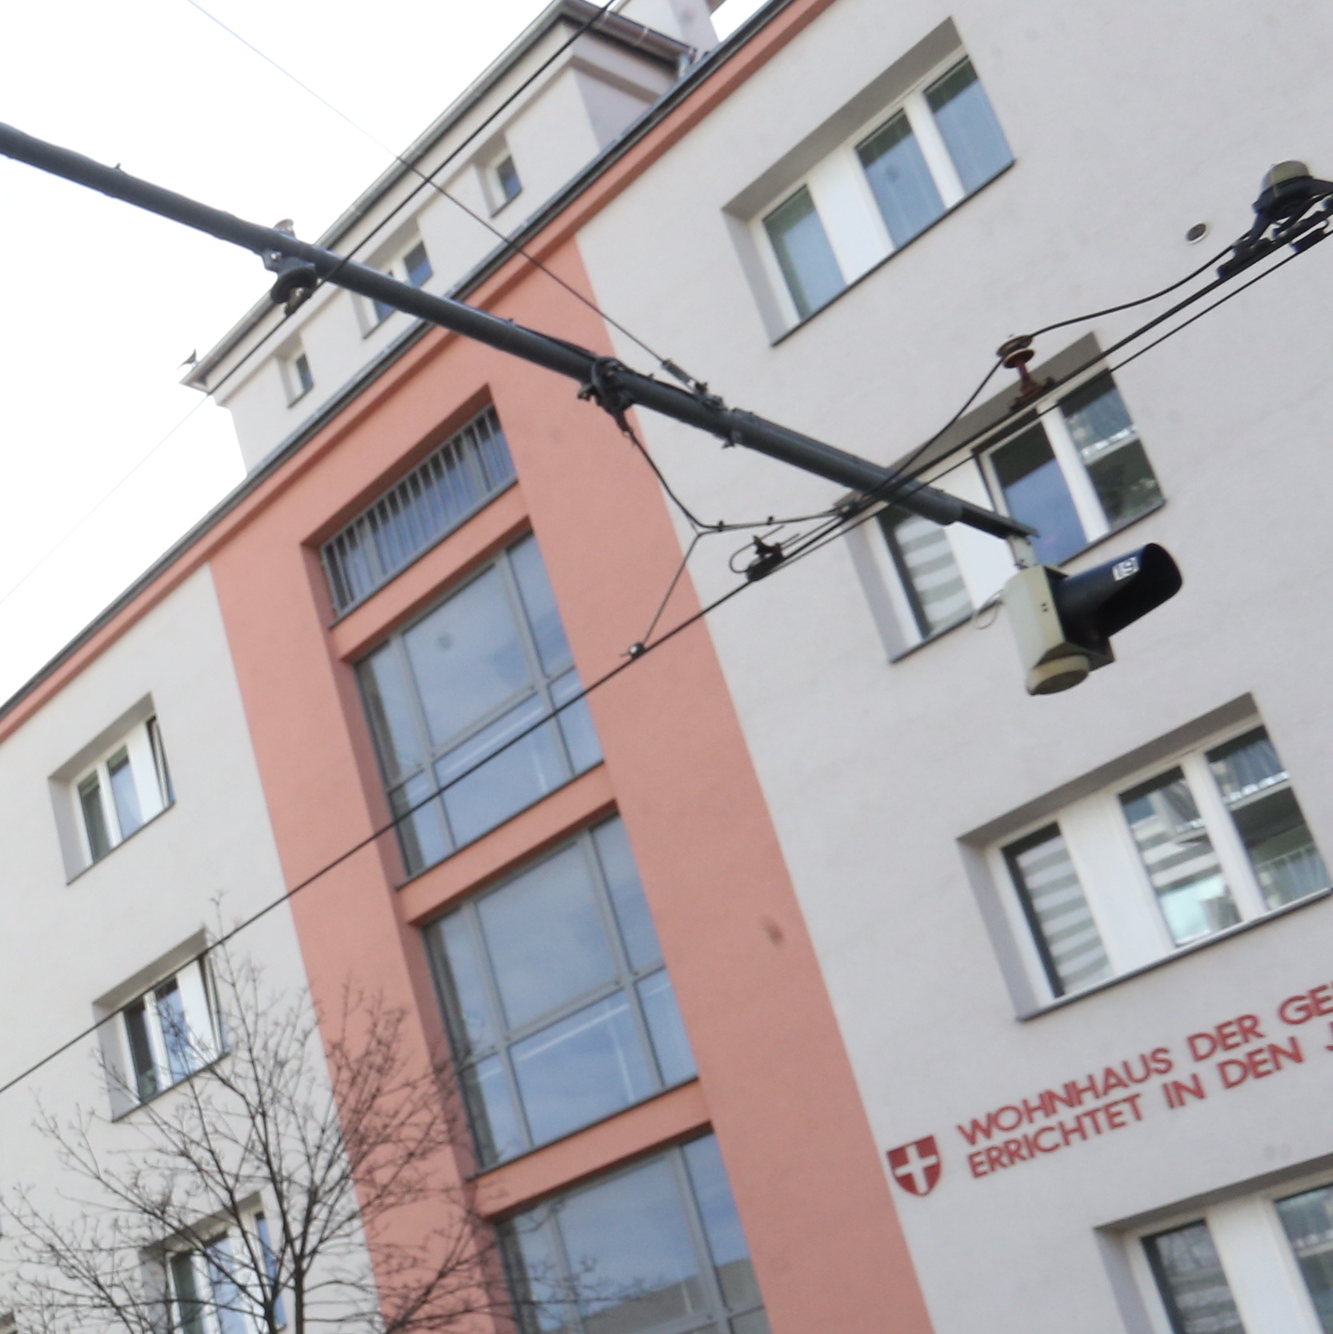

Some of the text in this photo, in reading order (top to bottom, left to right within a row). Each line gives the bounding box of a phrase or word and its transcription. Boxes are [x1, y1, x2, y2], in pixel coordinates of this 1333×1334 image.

[955, 1047, 1174, 1146] WOHNHAUS
[1186, 1013, 1266, 1063] DER
[966, 1093, 1144, 1178] ERRICHTET
[1161, 1072, 1206, 1110] IN
[1217, 1036, 1305, 1089] DEN
